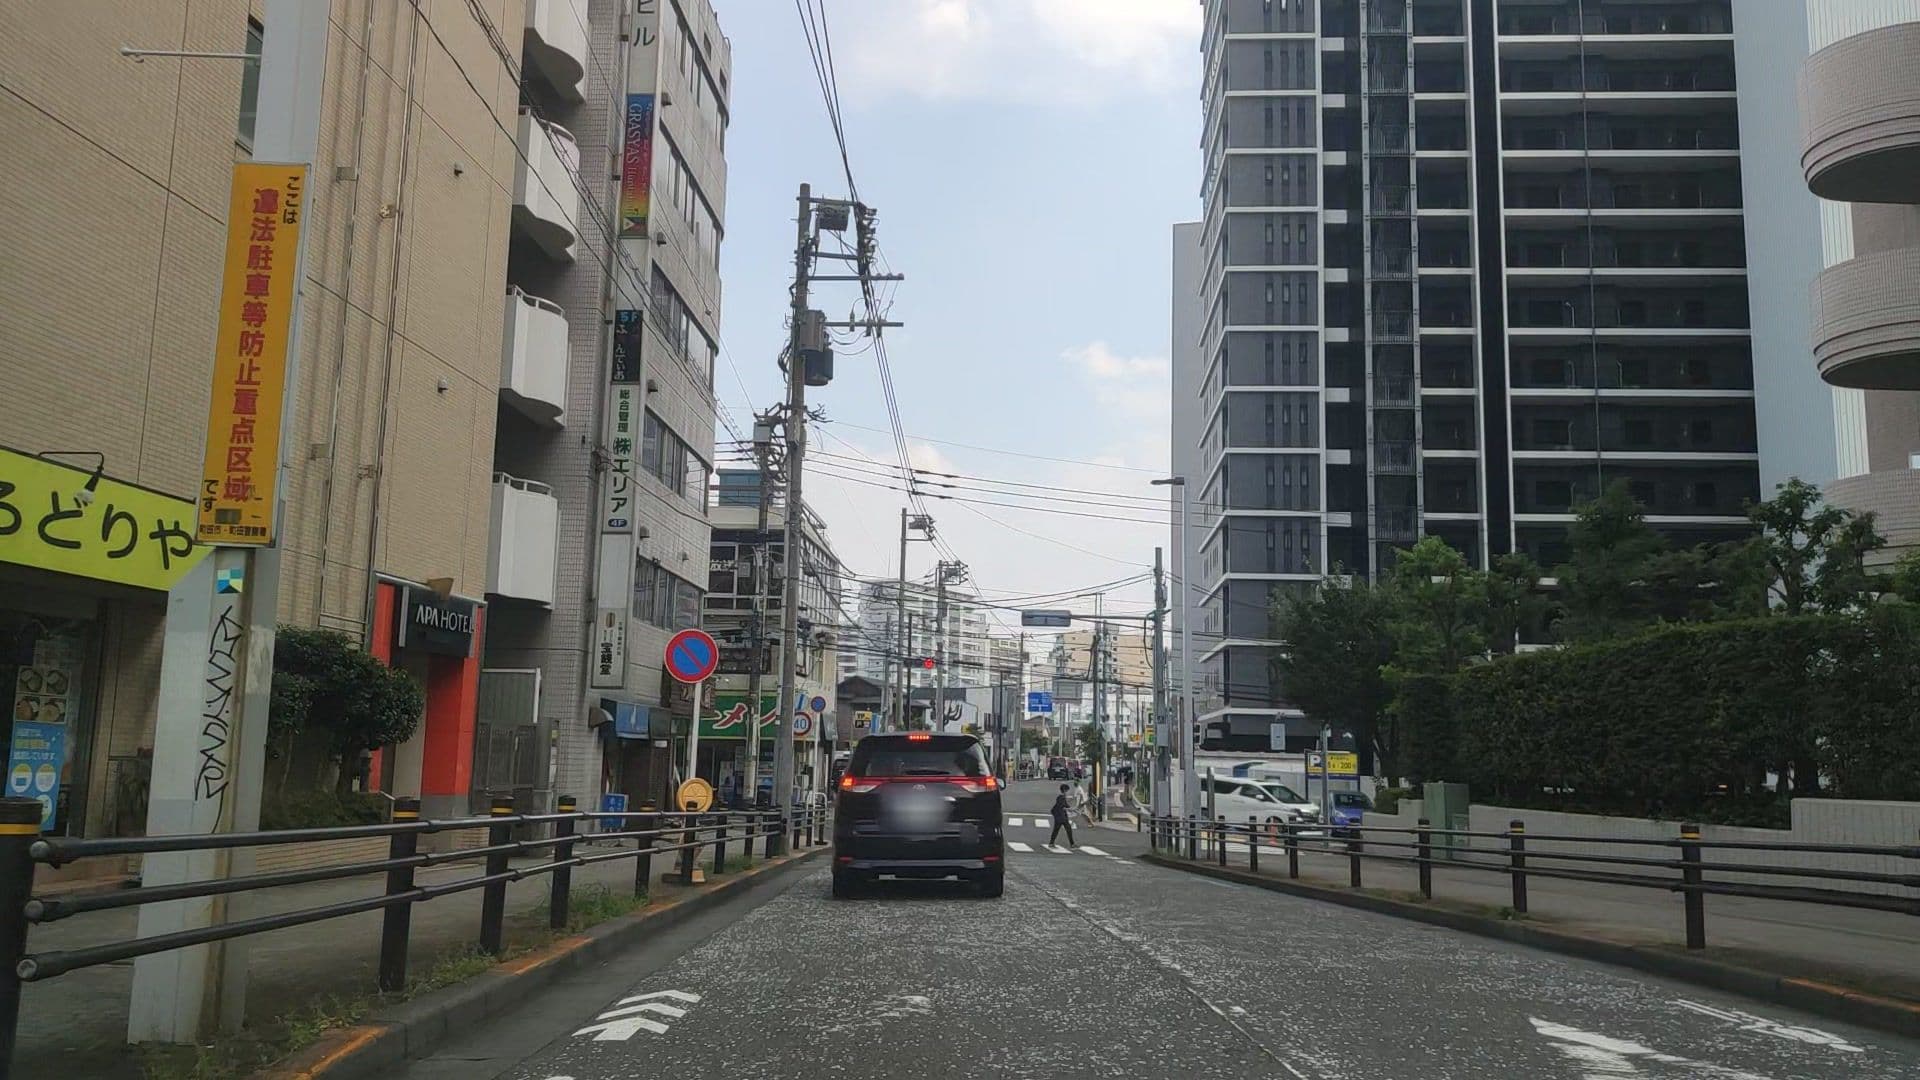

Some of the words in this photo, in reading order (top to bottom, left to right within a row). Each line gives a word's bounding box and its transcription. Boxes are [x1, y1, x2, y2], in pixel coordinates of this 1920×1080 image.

[283, 176, 299, 224] ここは
[222, 188, 279, 502] 違法駐車等防止重点区域
[203, 480, 219, 512] です
[610, 519, 625, 528] 4F
[416, 604, 438, 627] APA
[441, 610, 474, 633] HOTEL
[794, 718, 807, 730] 40
[1310, 754, 1322, 768] P
